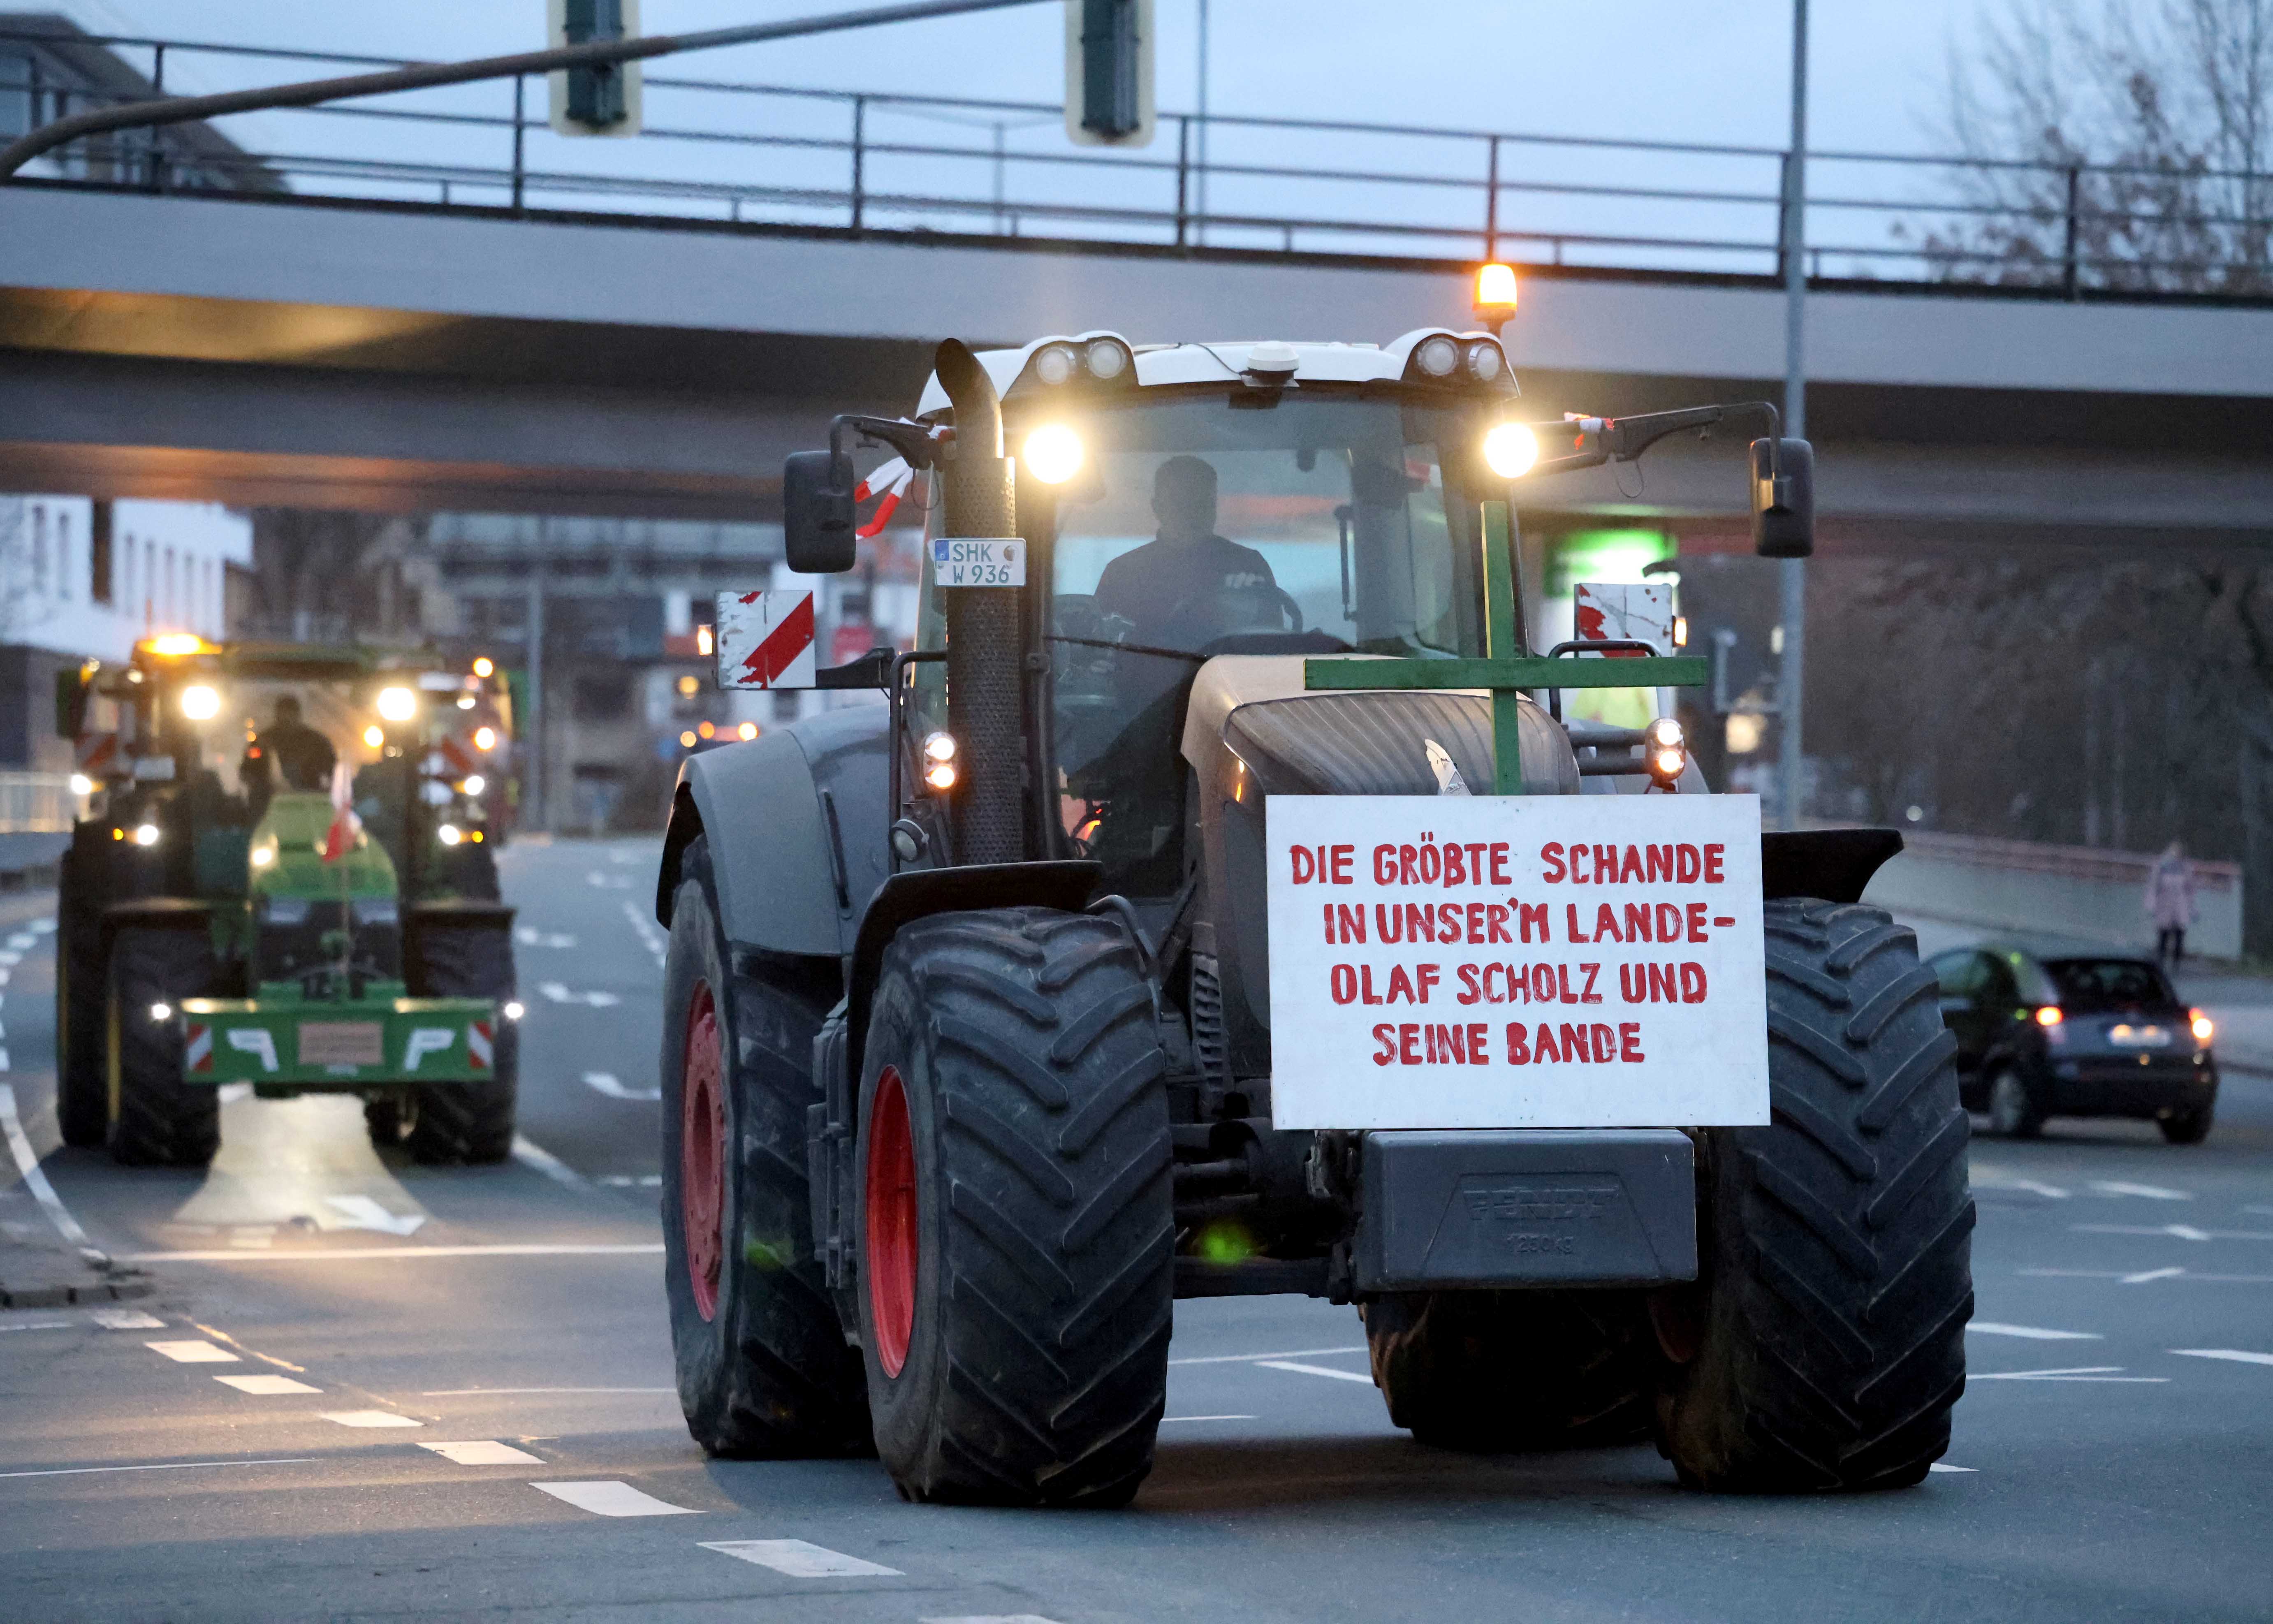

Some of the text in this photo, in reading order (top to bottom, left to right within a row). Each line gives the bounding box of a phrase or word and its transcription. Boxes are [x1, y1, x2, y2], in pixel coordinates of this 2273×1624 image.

[953, 543, 992, 562] SHK
[953, 565, 1009, 584] W 936
[1290, 844, 1354, 885] DIE
[1541, 842, 1724, 885] SCHANDE
[1324, 904, 1367, 945] IN
[1331, 962, 1707, 1005] OLAF SCHOLZ UND
[1373, 1022, 1645, 1066] SEINE BANDE
